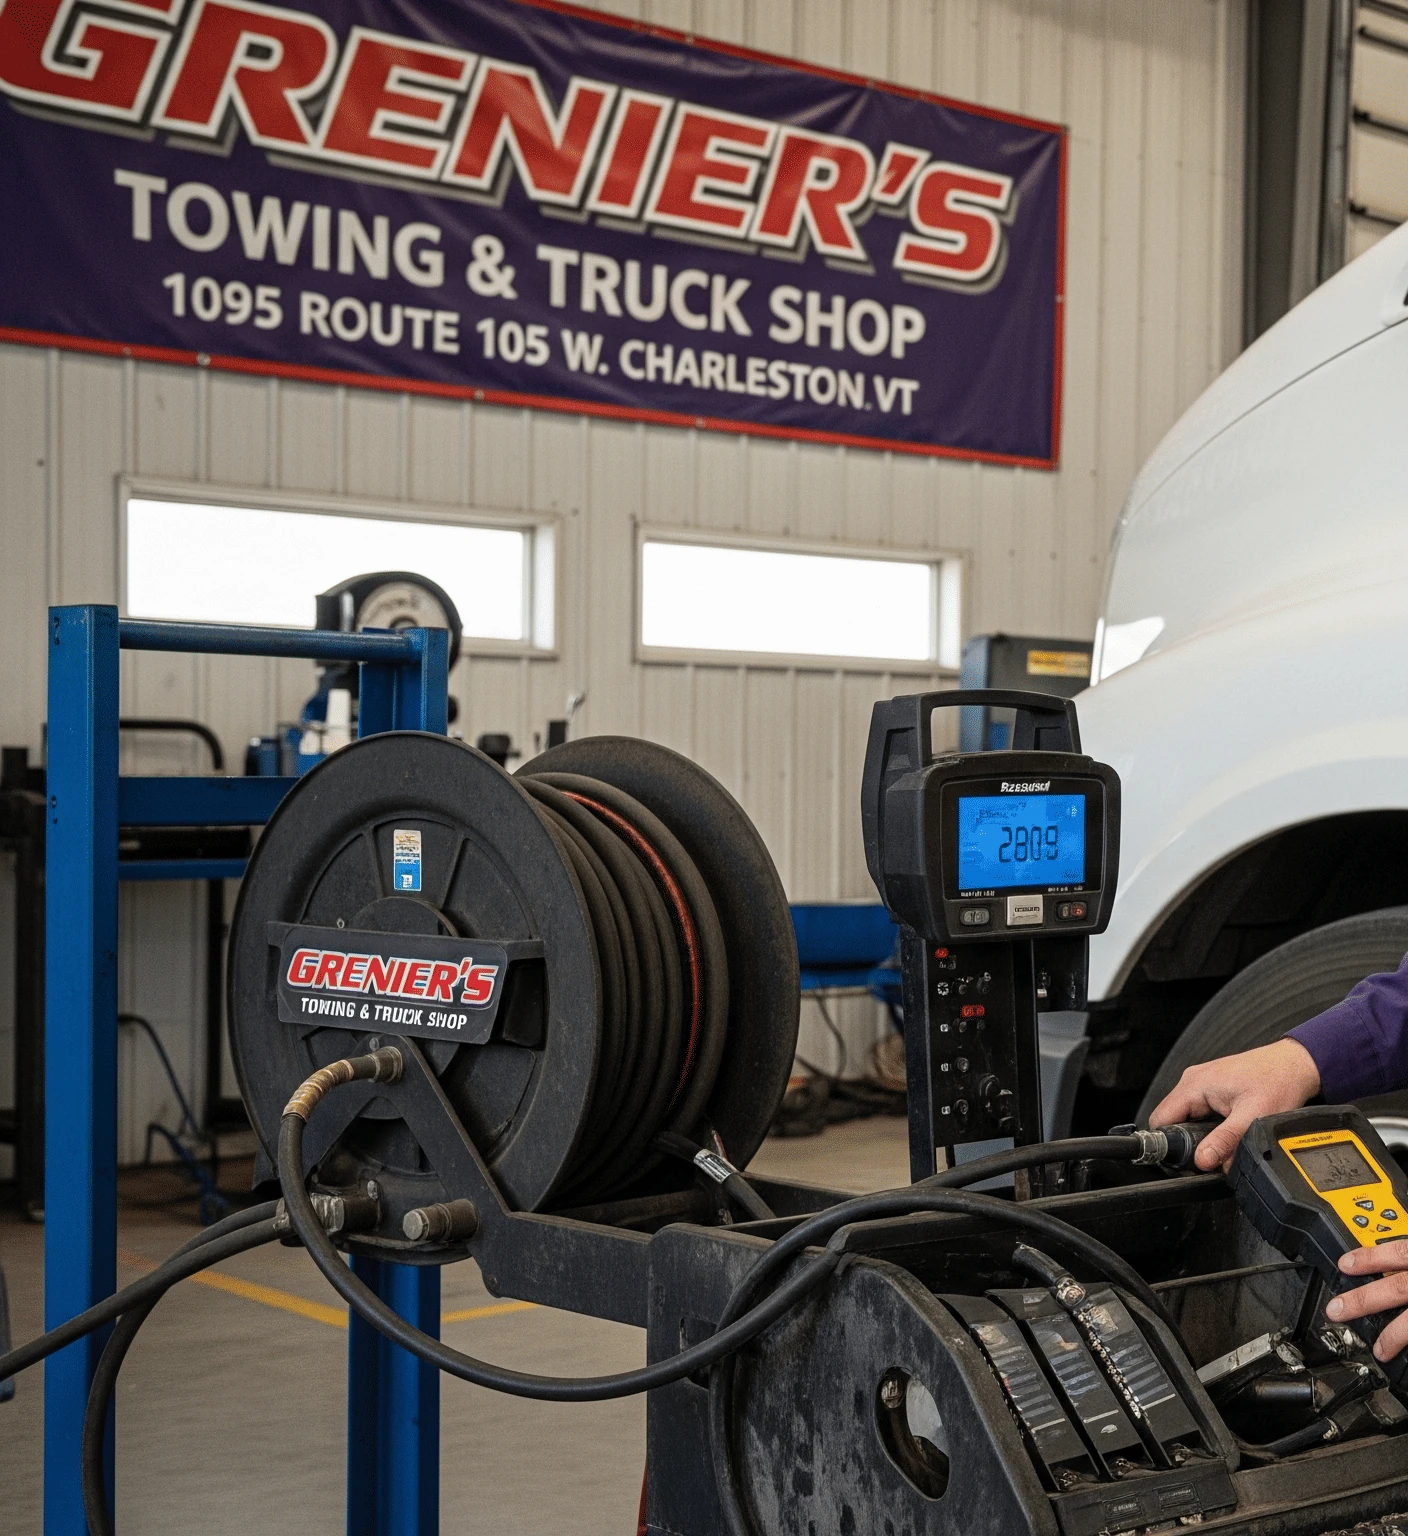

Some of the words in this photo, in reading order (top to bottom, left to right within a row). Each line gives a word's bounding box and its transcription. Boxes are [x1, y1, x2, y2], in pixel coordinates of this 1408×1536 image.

[0, 0, 1012, 284] GRENIER'S
[114, 168, 446, 288] TOWING
[466, 236, 517, 301] &
[536, 244, 752, 338] TRUCK
[767, 286, 926, 361] SHOP
[162, 272, 283, 330] 1095
[299, 292, 460, 355] ROUTE
[476, 317, 550, 366] 105
[561, 334, 609, 375] W.
[287, 948, 499, 1005] GRENIER'S
[359, 1004, 370, 1020] &
